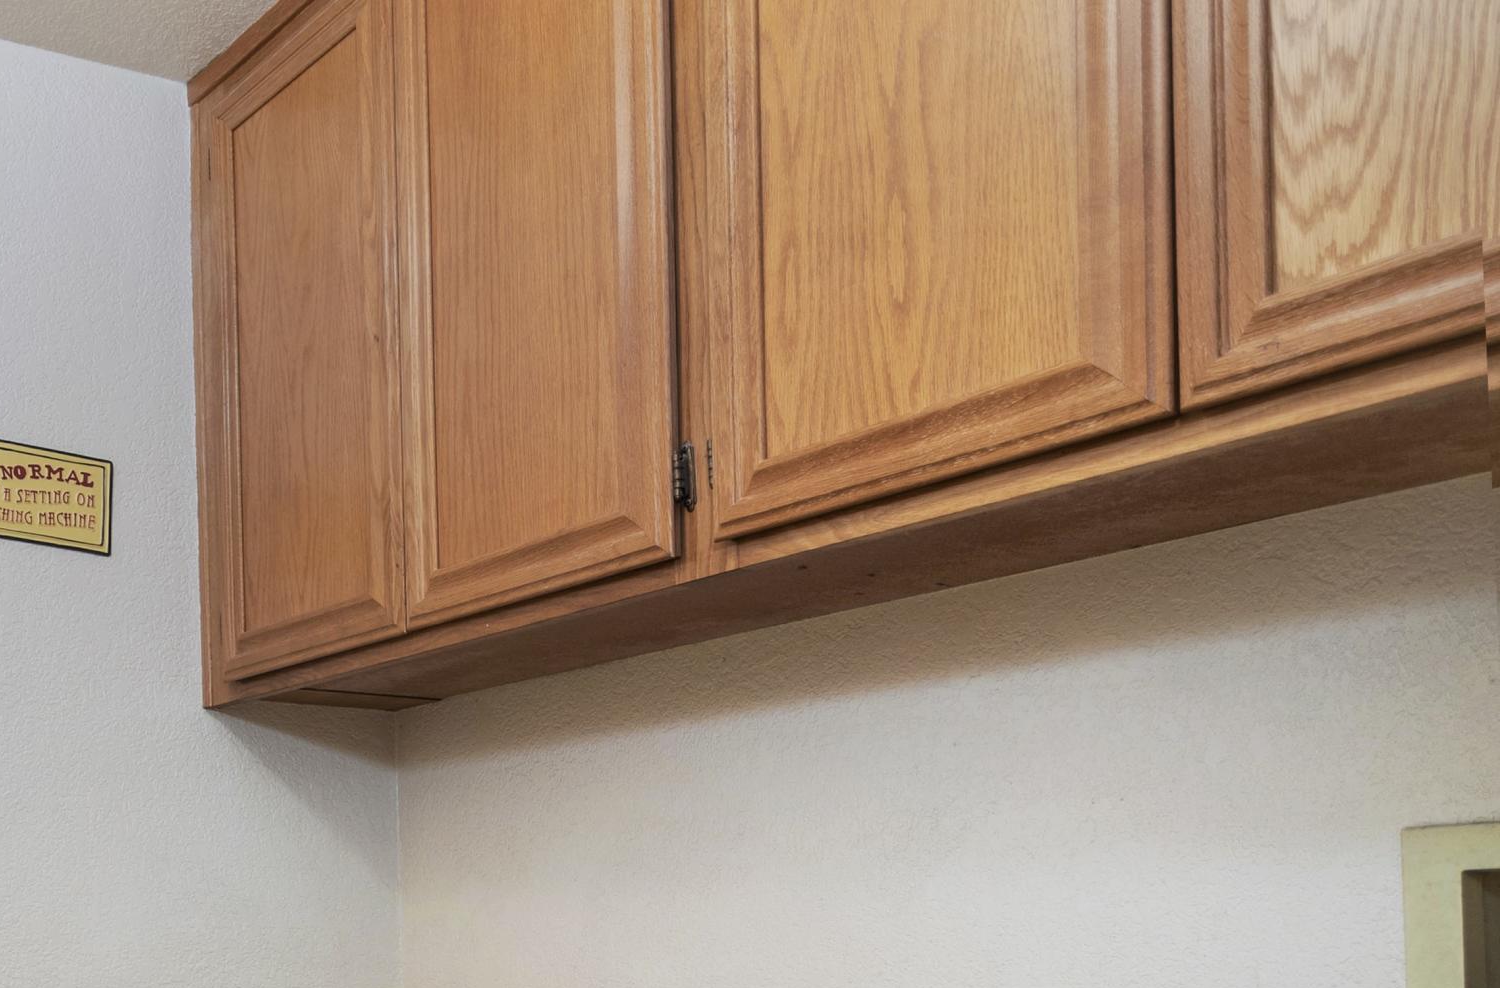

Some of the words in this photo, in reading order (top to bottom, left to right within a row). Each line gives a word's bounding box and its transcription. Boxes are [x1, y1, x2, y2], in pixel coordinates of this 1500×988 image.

[0, 464, 94, 488] NORMAL
[3, 488, 12, 502] A
[16, 488, 70, 505] SETTING
[76, 492, 96, 508] ON
[38, 512, 96, 530] MACHINE
